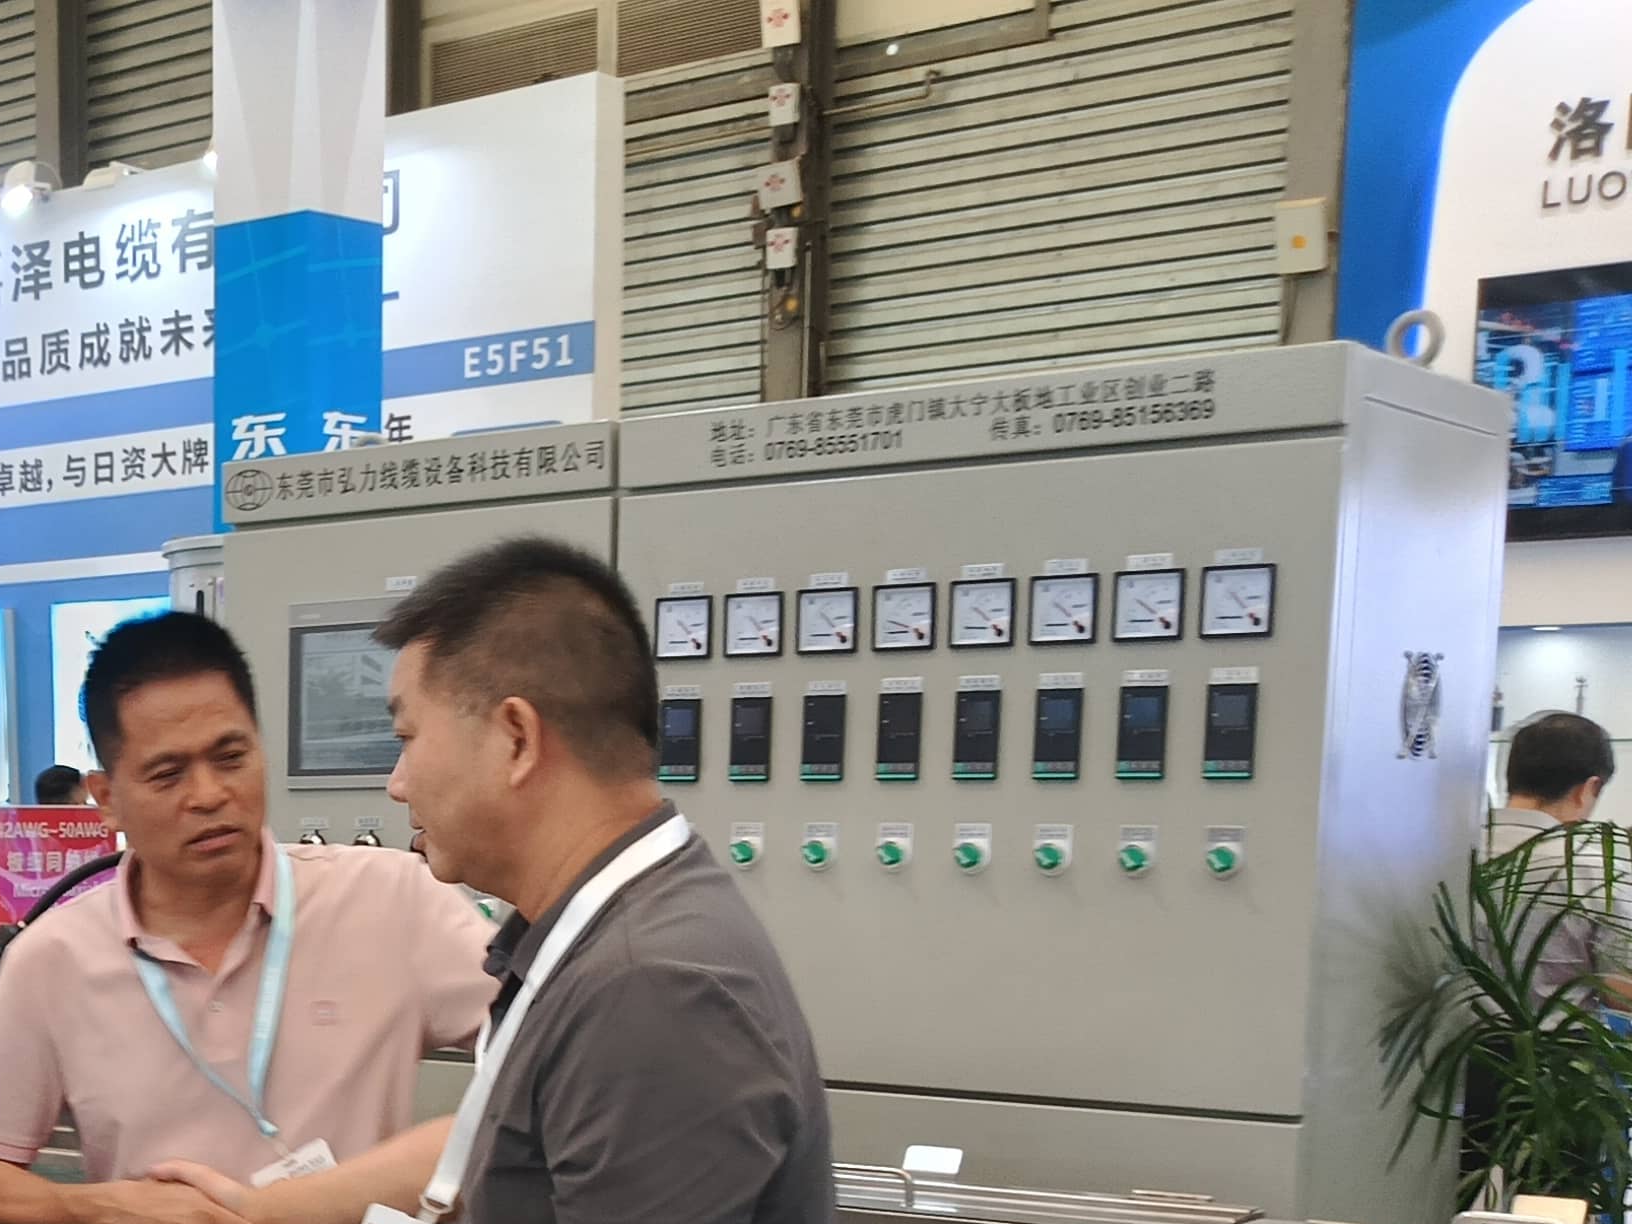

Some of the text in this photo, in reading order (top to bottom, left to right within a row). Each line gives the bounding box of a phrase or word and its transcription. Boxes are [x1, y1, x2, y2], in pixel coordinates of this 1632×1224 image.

[463, 334, 575, 379] E5F51
[1052, 399, 1216, 434] 0769-85156369
[765, 429, 903, 461] 0769-85551701
[275, 440, 605, 502] 东莞市弘力线缆设备科技有限公司
